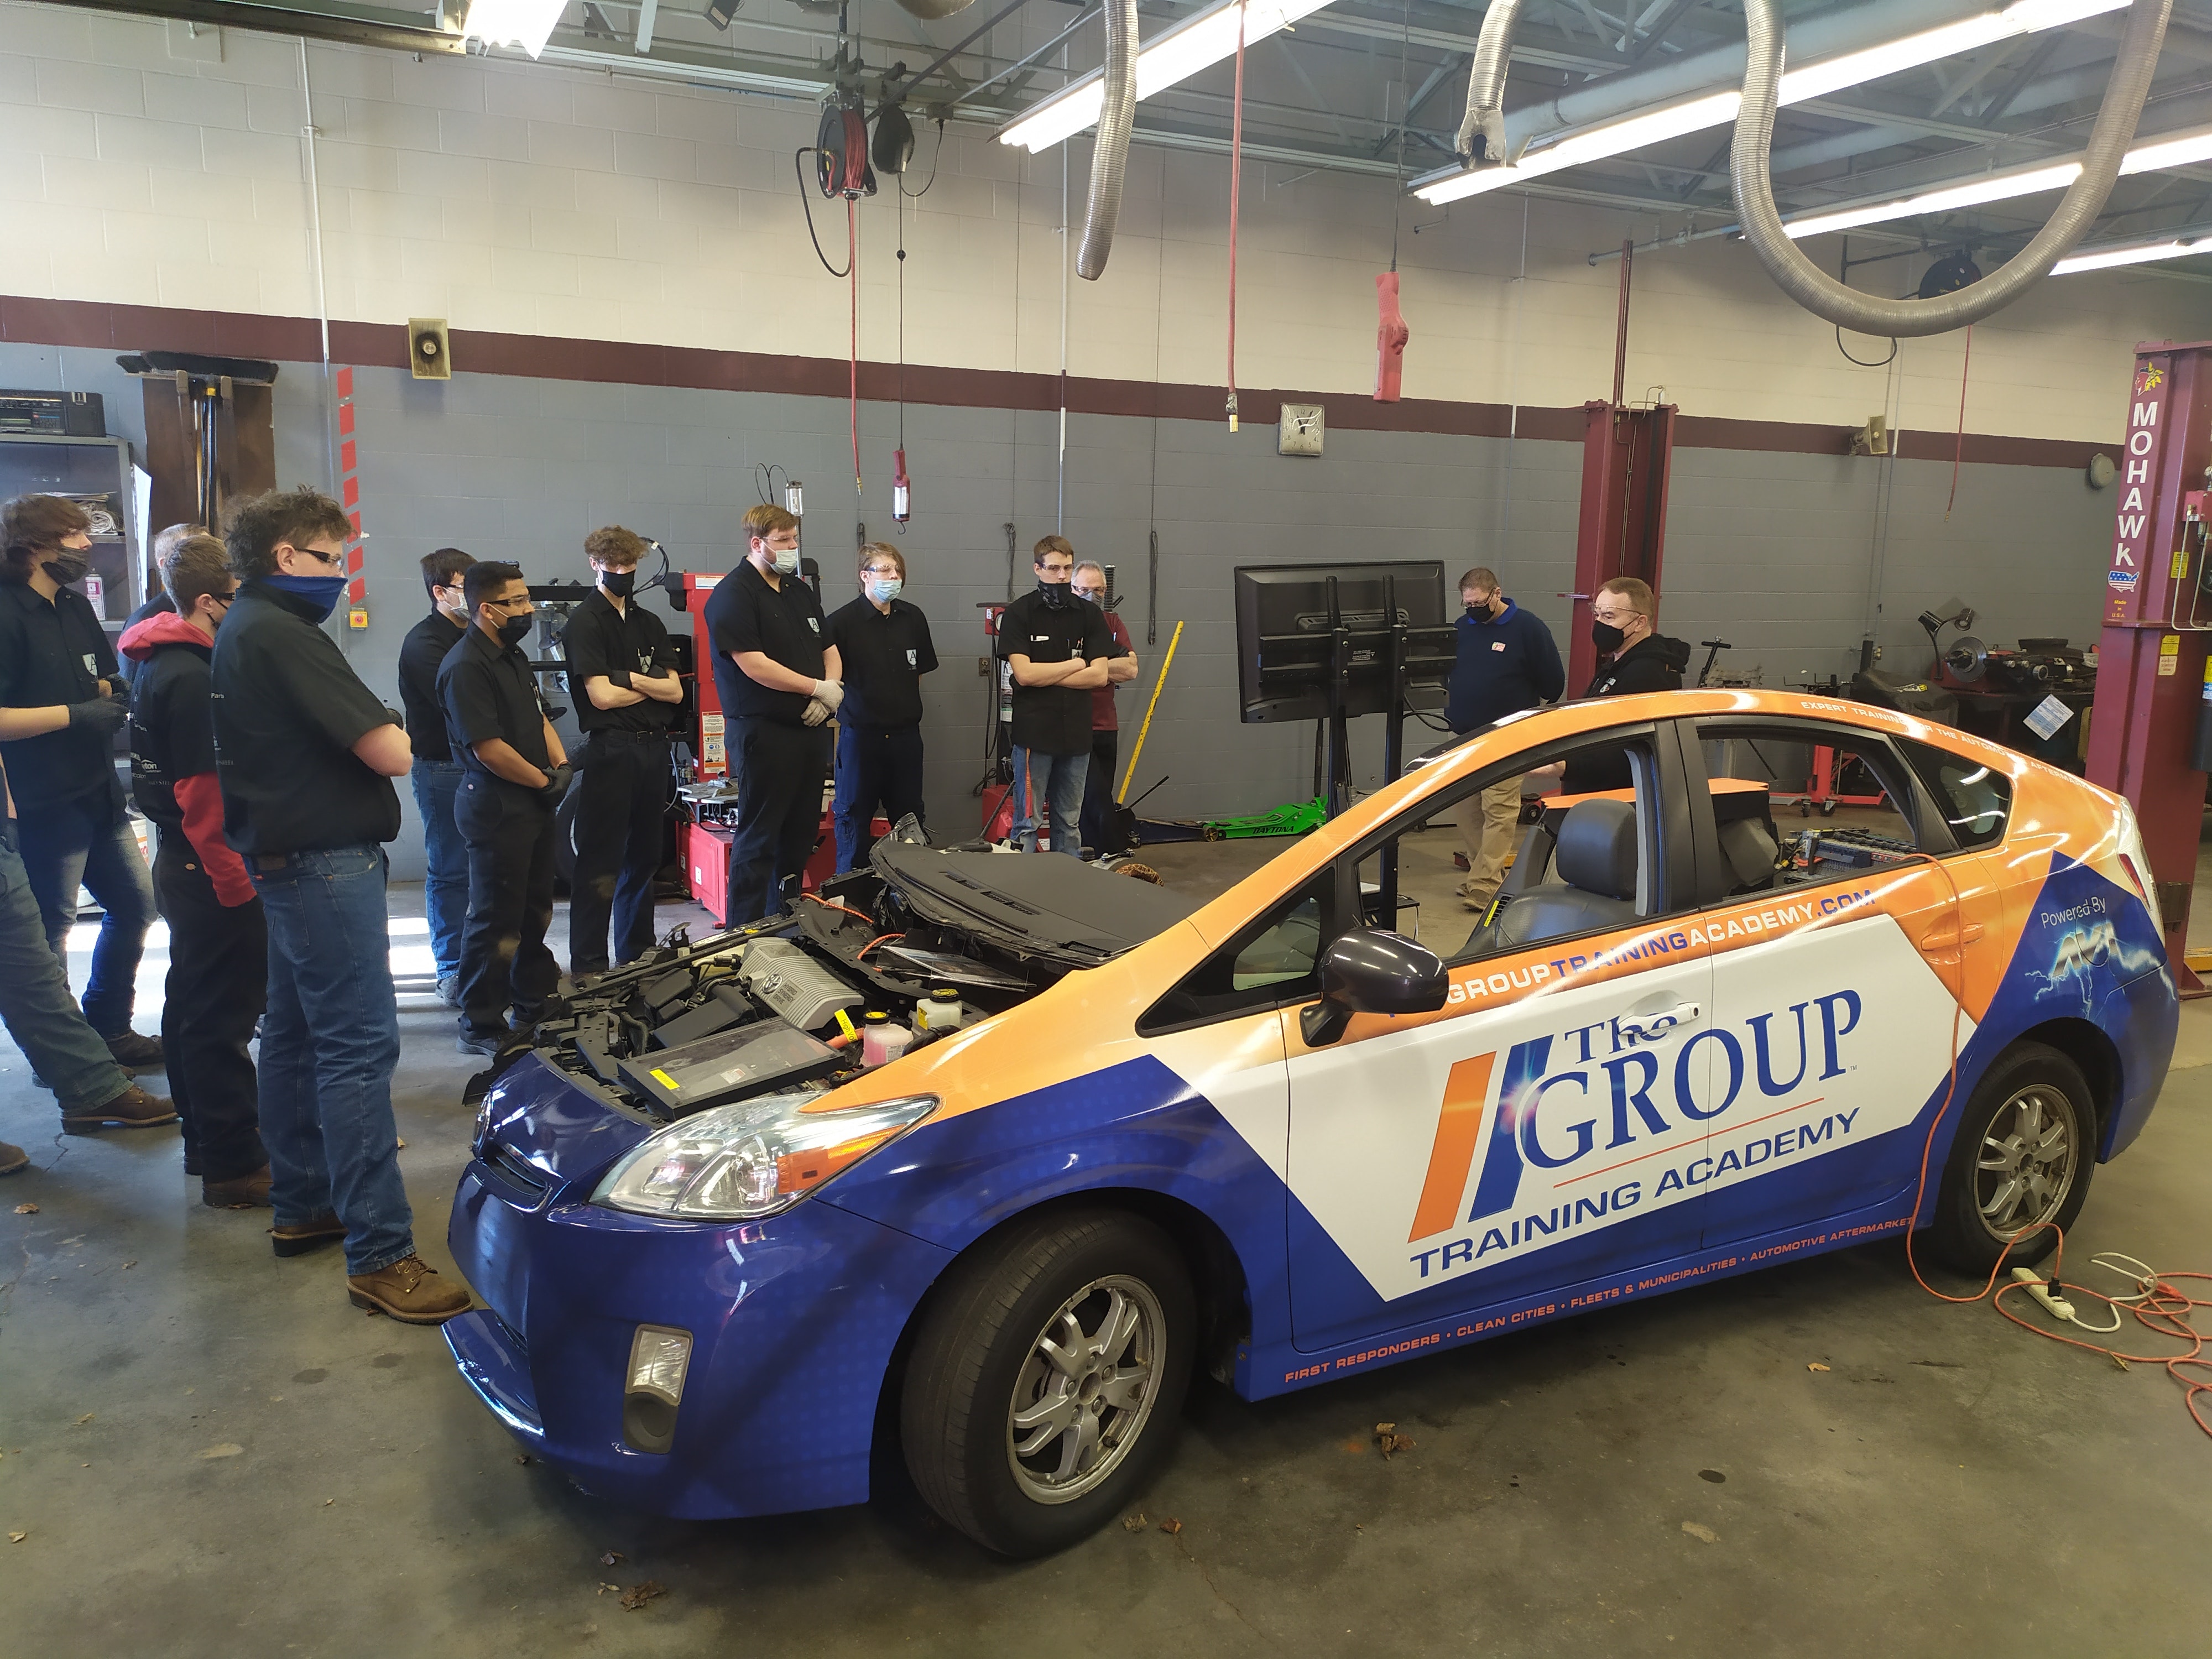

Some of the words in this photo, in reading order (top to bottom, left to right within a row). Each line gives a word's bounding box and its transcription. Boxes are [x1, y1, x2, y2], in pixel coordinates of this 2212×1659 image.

[2115, 401, 2158, 566] MOHAWK
[1801, 701, 1848, 713] EXPERT
[1936, 728, 1958, 739] THE
[1252, 826, 1295, 834] DAYTONA
[2041, 898, 2091, 929] Powered
[2091, 896, 2106, 914] By
[773, 994, 785, 1005] DRIVE
[778, 988, 795, 1003] SYNERGY
[783, 983, 797, 995] HYBRID
[841, 1019, 851, 1033] High
[1564, 1012, 1678, 1065] The
[1520, 989, 1862, 1169] GROUP
[1410, 1181, 1641, 1279] TRAINING
[1653, 1107, 1861, 1199] ACADEMY
[1285, 1361, 1331, 1383] FIRST
[1336, 1333, 1441, 1369] RESPONDERS
[1457, 1317, 1506, 1337] CLEAN
[1511, 1303, 1556, 1323] CITIES
[1571, 1287, 1620, 1309] FLEETS
[1625, 1284, 1634, 1295] &
[1639, 1257, 1737, 1291] MUNICIPALITIES
[1750, 1234, 1825, 1261] AUTOMOTIVE
[1830, 1217, 1913, 1241] AFTERMARKET
